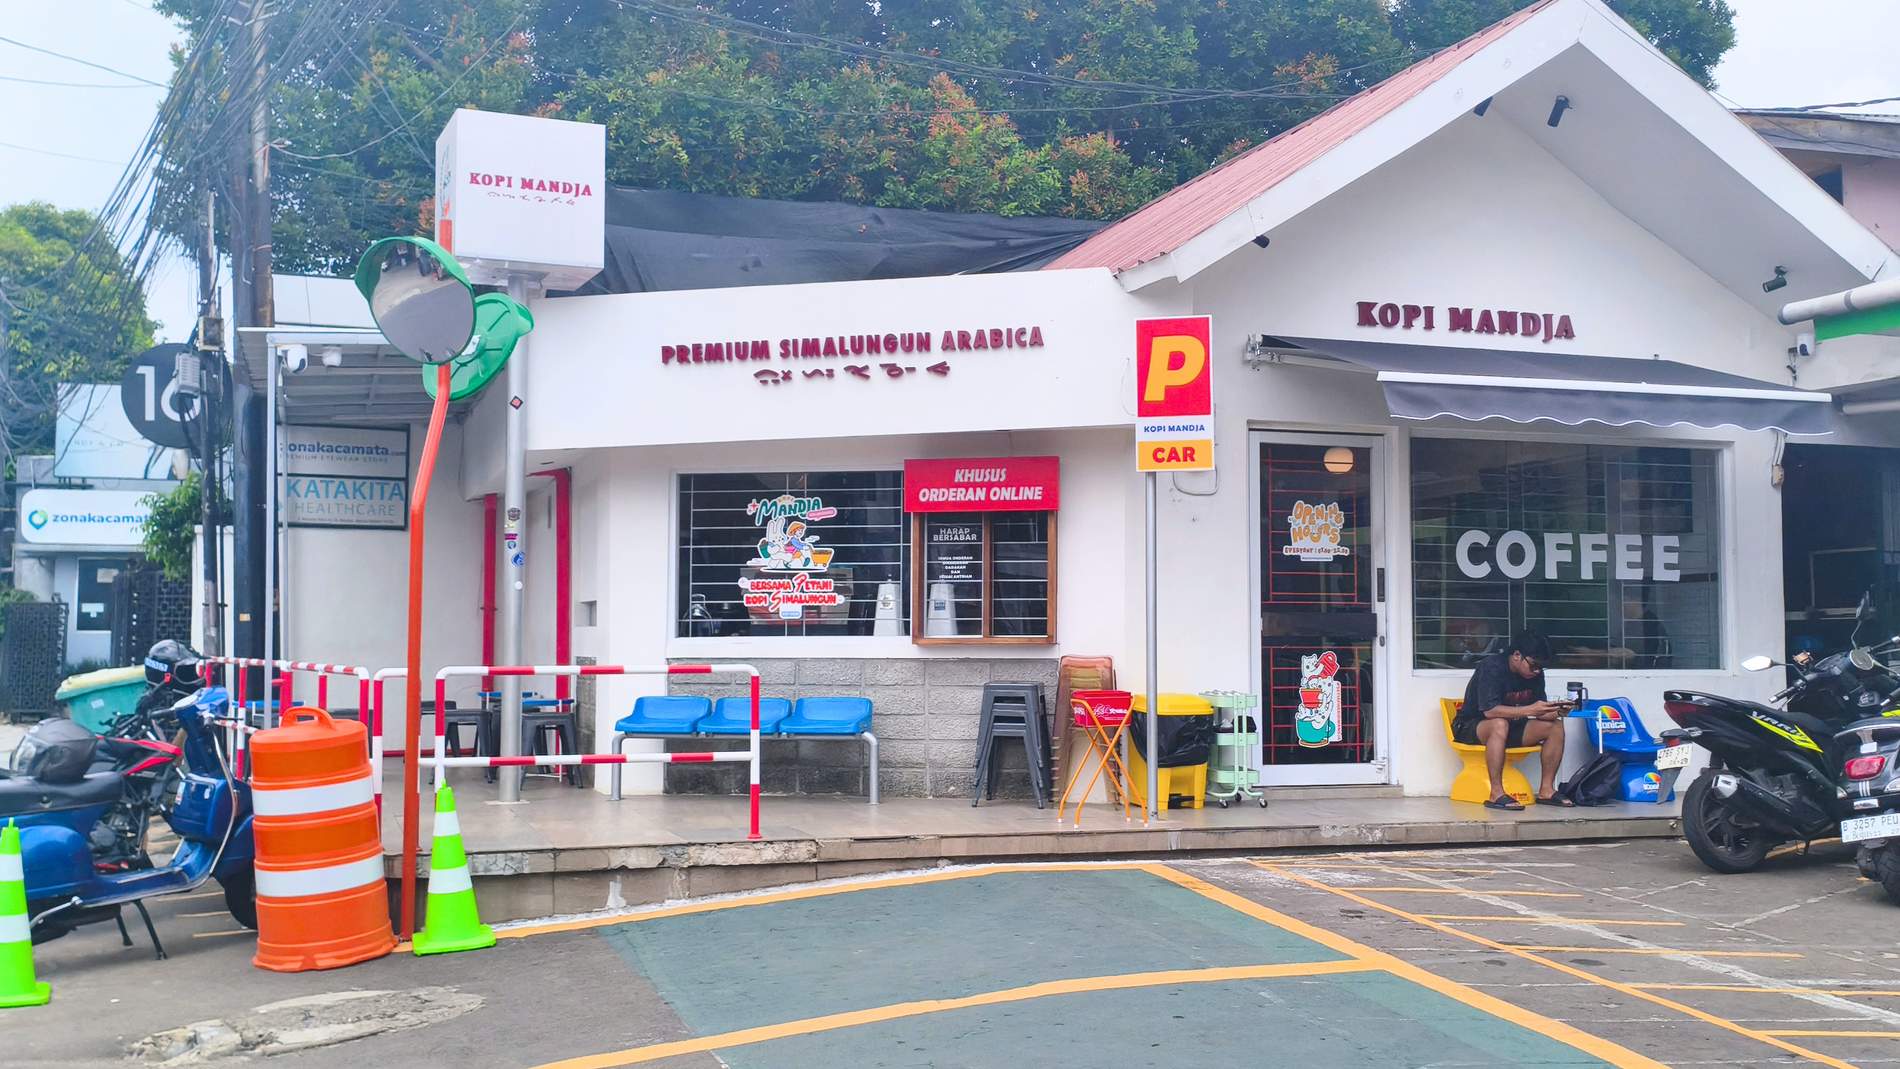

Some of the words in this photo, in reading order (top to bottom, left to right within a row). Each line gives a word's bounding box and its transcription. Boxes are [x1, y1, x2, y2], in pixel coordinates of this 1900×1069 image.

[470, 172, 513, 188] KOPI
[520, 177, 593, 198] MANDJA
[1356, 301, 1436, 331] KOPI
[1447, 307, 1576, 343] MANDJA
[661, 340, 771, 365] PREMIUM
[779, 332, 931, 360] SIMALUNGUN
[940, 326, 1045, 351] ARABICA
[1143, 334, 1206, 403] P
[1143, 425, 1166, 433] KOPI
[1168, 424, 1205, 432] MANDJA
[1152, 446, 1196, 463] CAR
[954, 468, 1007, 483] KHUSUS
[287, 478, 405, 501] KATAKITA
[918, 487, 986, 502] ORDERAN
[989, 486, 1043, 501] ONLINE
[52, 512, 150, 524] zonakacamat
[295, 502, 396, 516] HEALTHCARE
[1294, 501, 1343, 525] OPENING
[1292, 523, 1339, 543] HOURS
[1455, 529, 1681, 582] COFFEE
[750, 580, 792, 591] BERSAMA
[794, 573, 832, 592] PETANI
[745, 595, 767, 605] KOPI
[770, 591, 837, 610] SIMALUNGUN
[1842, 822, 1848, 832] B
[1853, 817, 1876, 830] 3257
[1881, 815, 1899, 826] PEU
